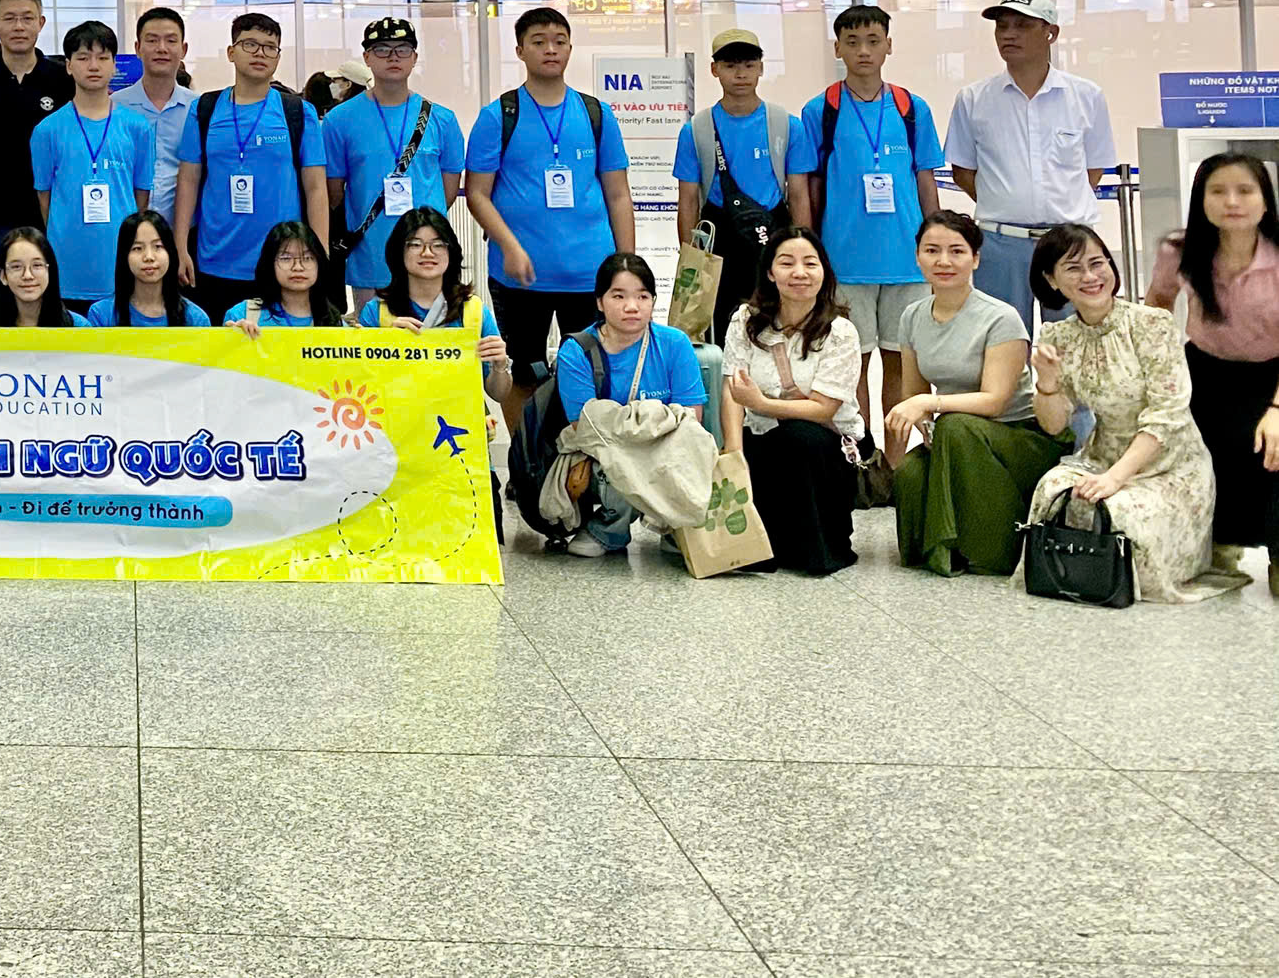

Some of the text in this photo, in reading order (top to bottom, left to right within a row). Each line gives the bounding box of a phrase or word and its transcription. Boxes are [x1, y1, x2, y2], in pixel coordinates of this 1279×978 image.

[604, 74, 644, 91] NIA
[1224, 86, 1279, 94] ITEMS NOT
[610, 101, 621, 112] ỐI
[660, 203, 678, 211] KHÔN
[301, 346, 462, 361] HOTLINE 0904 281 599
[22, 435, 115, 478] NGỮ
[118, 429, 244, 486] QUỐC
[247, 429, 308, 481] TẾ
[21, 501, 42, 516] Đi
[46, 499, 72, 517] để
[76, 500, 141, 522] trưởng
[148, 502, 204, 521] thành
